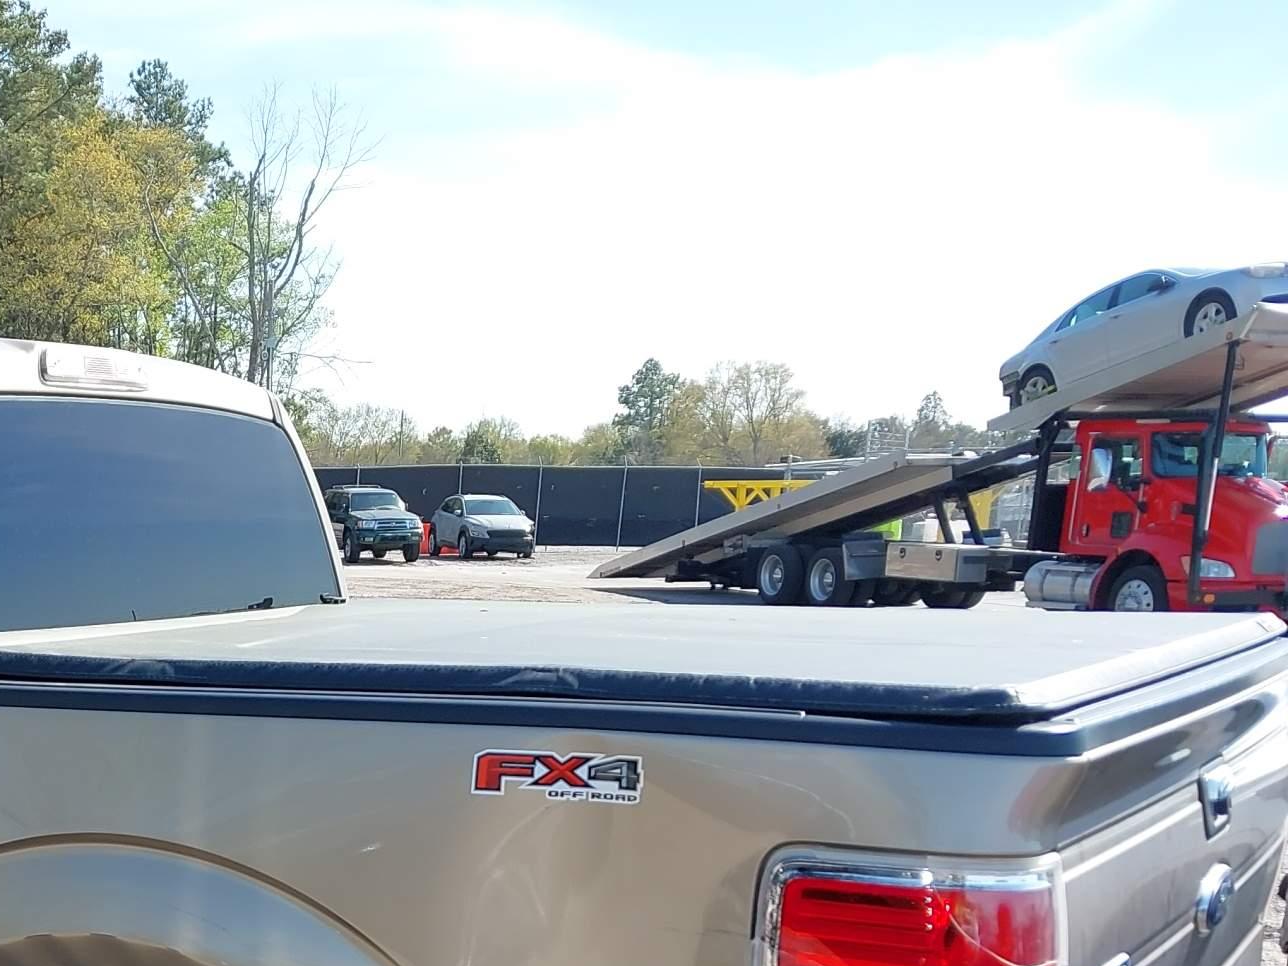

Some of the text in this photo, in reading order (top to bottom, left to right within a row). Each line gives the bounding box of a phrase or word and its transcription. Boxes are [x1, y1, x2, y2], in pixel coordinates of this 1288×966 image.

[473, 751, 642, 793] FX4
[547, 790, 638, 803] OFF ROAD
